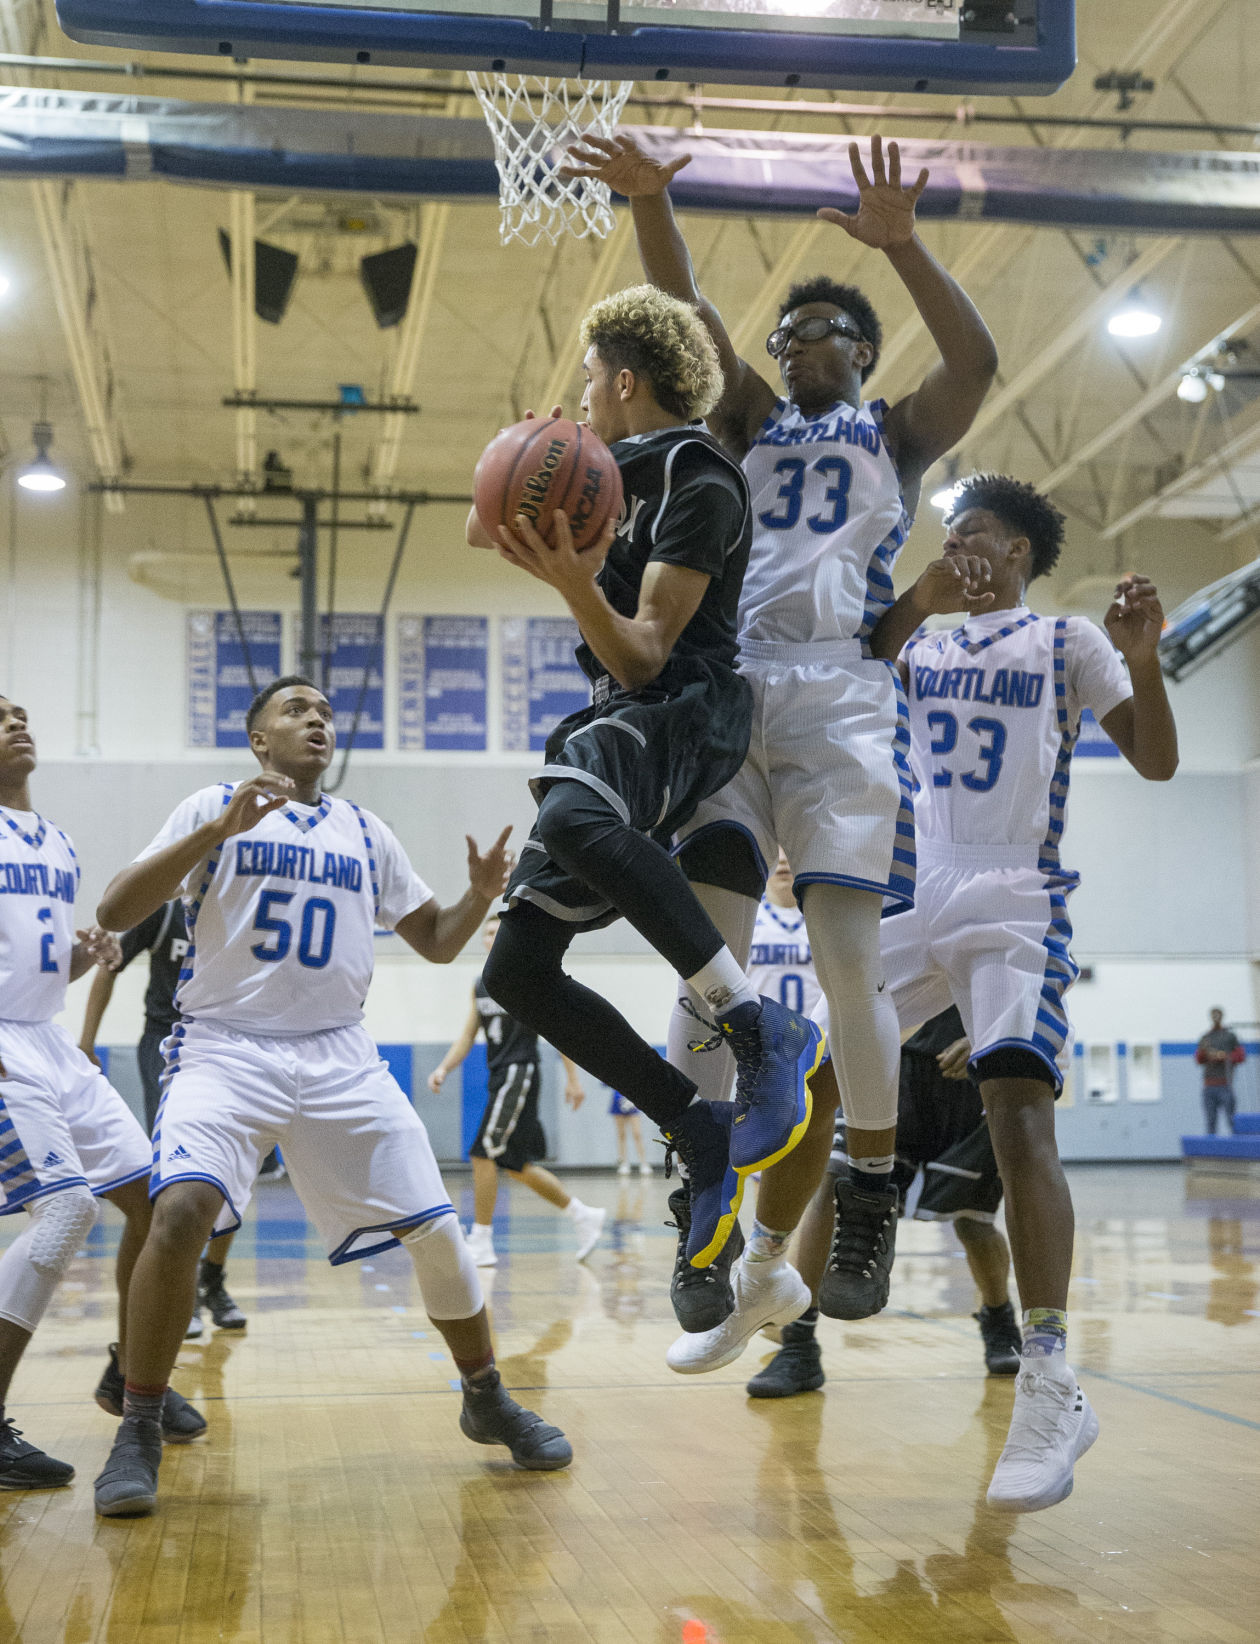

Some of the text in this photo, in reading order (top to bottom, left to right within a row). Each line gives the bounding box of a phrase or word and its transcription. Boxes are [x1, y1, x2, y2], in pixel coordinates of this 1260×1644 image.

[757, 415, 881, 456] RTLAND
[758, 455, 853, 535] 33
[926, 709, 1008, 793] 23
[236, 840, 363, 894] COURTLAND
[37, 907, 60, 974] 2
[251, 888, 337, 970] 50
[779, 972, 804, 1015] 0
